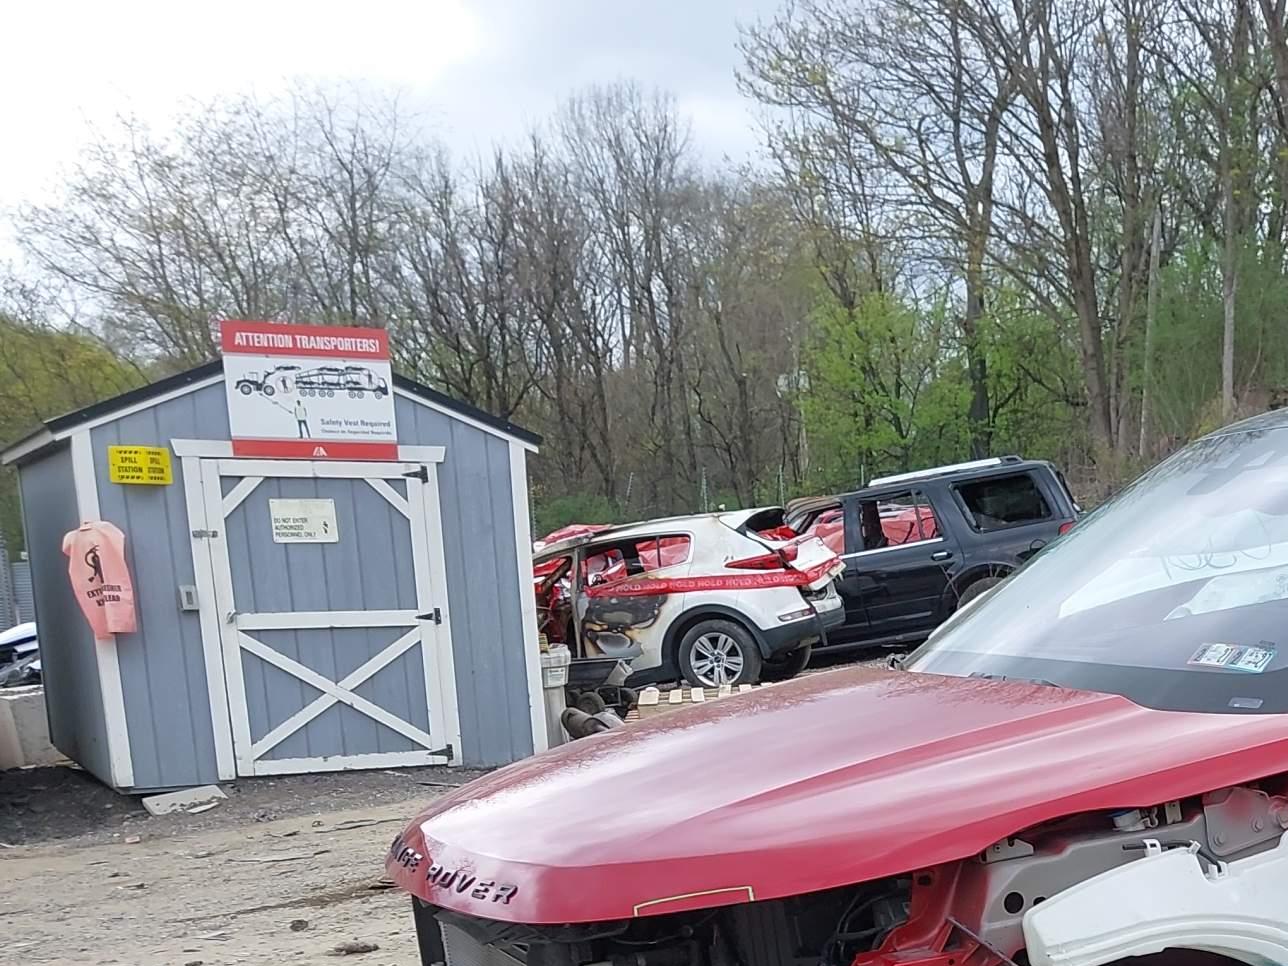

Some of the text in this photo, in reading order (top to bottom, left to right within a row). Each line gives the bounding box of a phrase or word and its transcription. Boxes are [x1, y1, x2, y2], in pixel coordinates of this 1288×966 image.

[234, 332, 380, 353] ATTENTION TRANSPORTERS!
[320, 418, 391, 429] Safety Vest Required
[117, 465, 143, 473] STATION
[697, 579, 723, 588] HOLD
[725, 578, 752, 587] HOLD
[425, 864, 519, 905] ROVER
